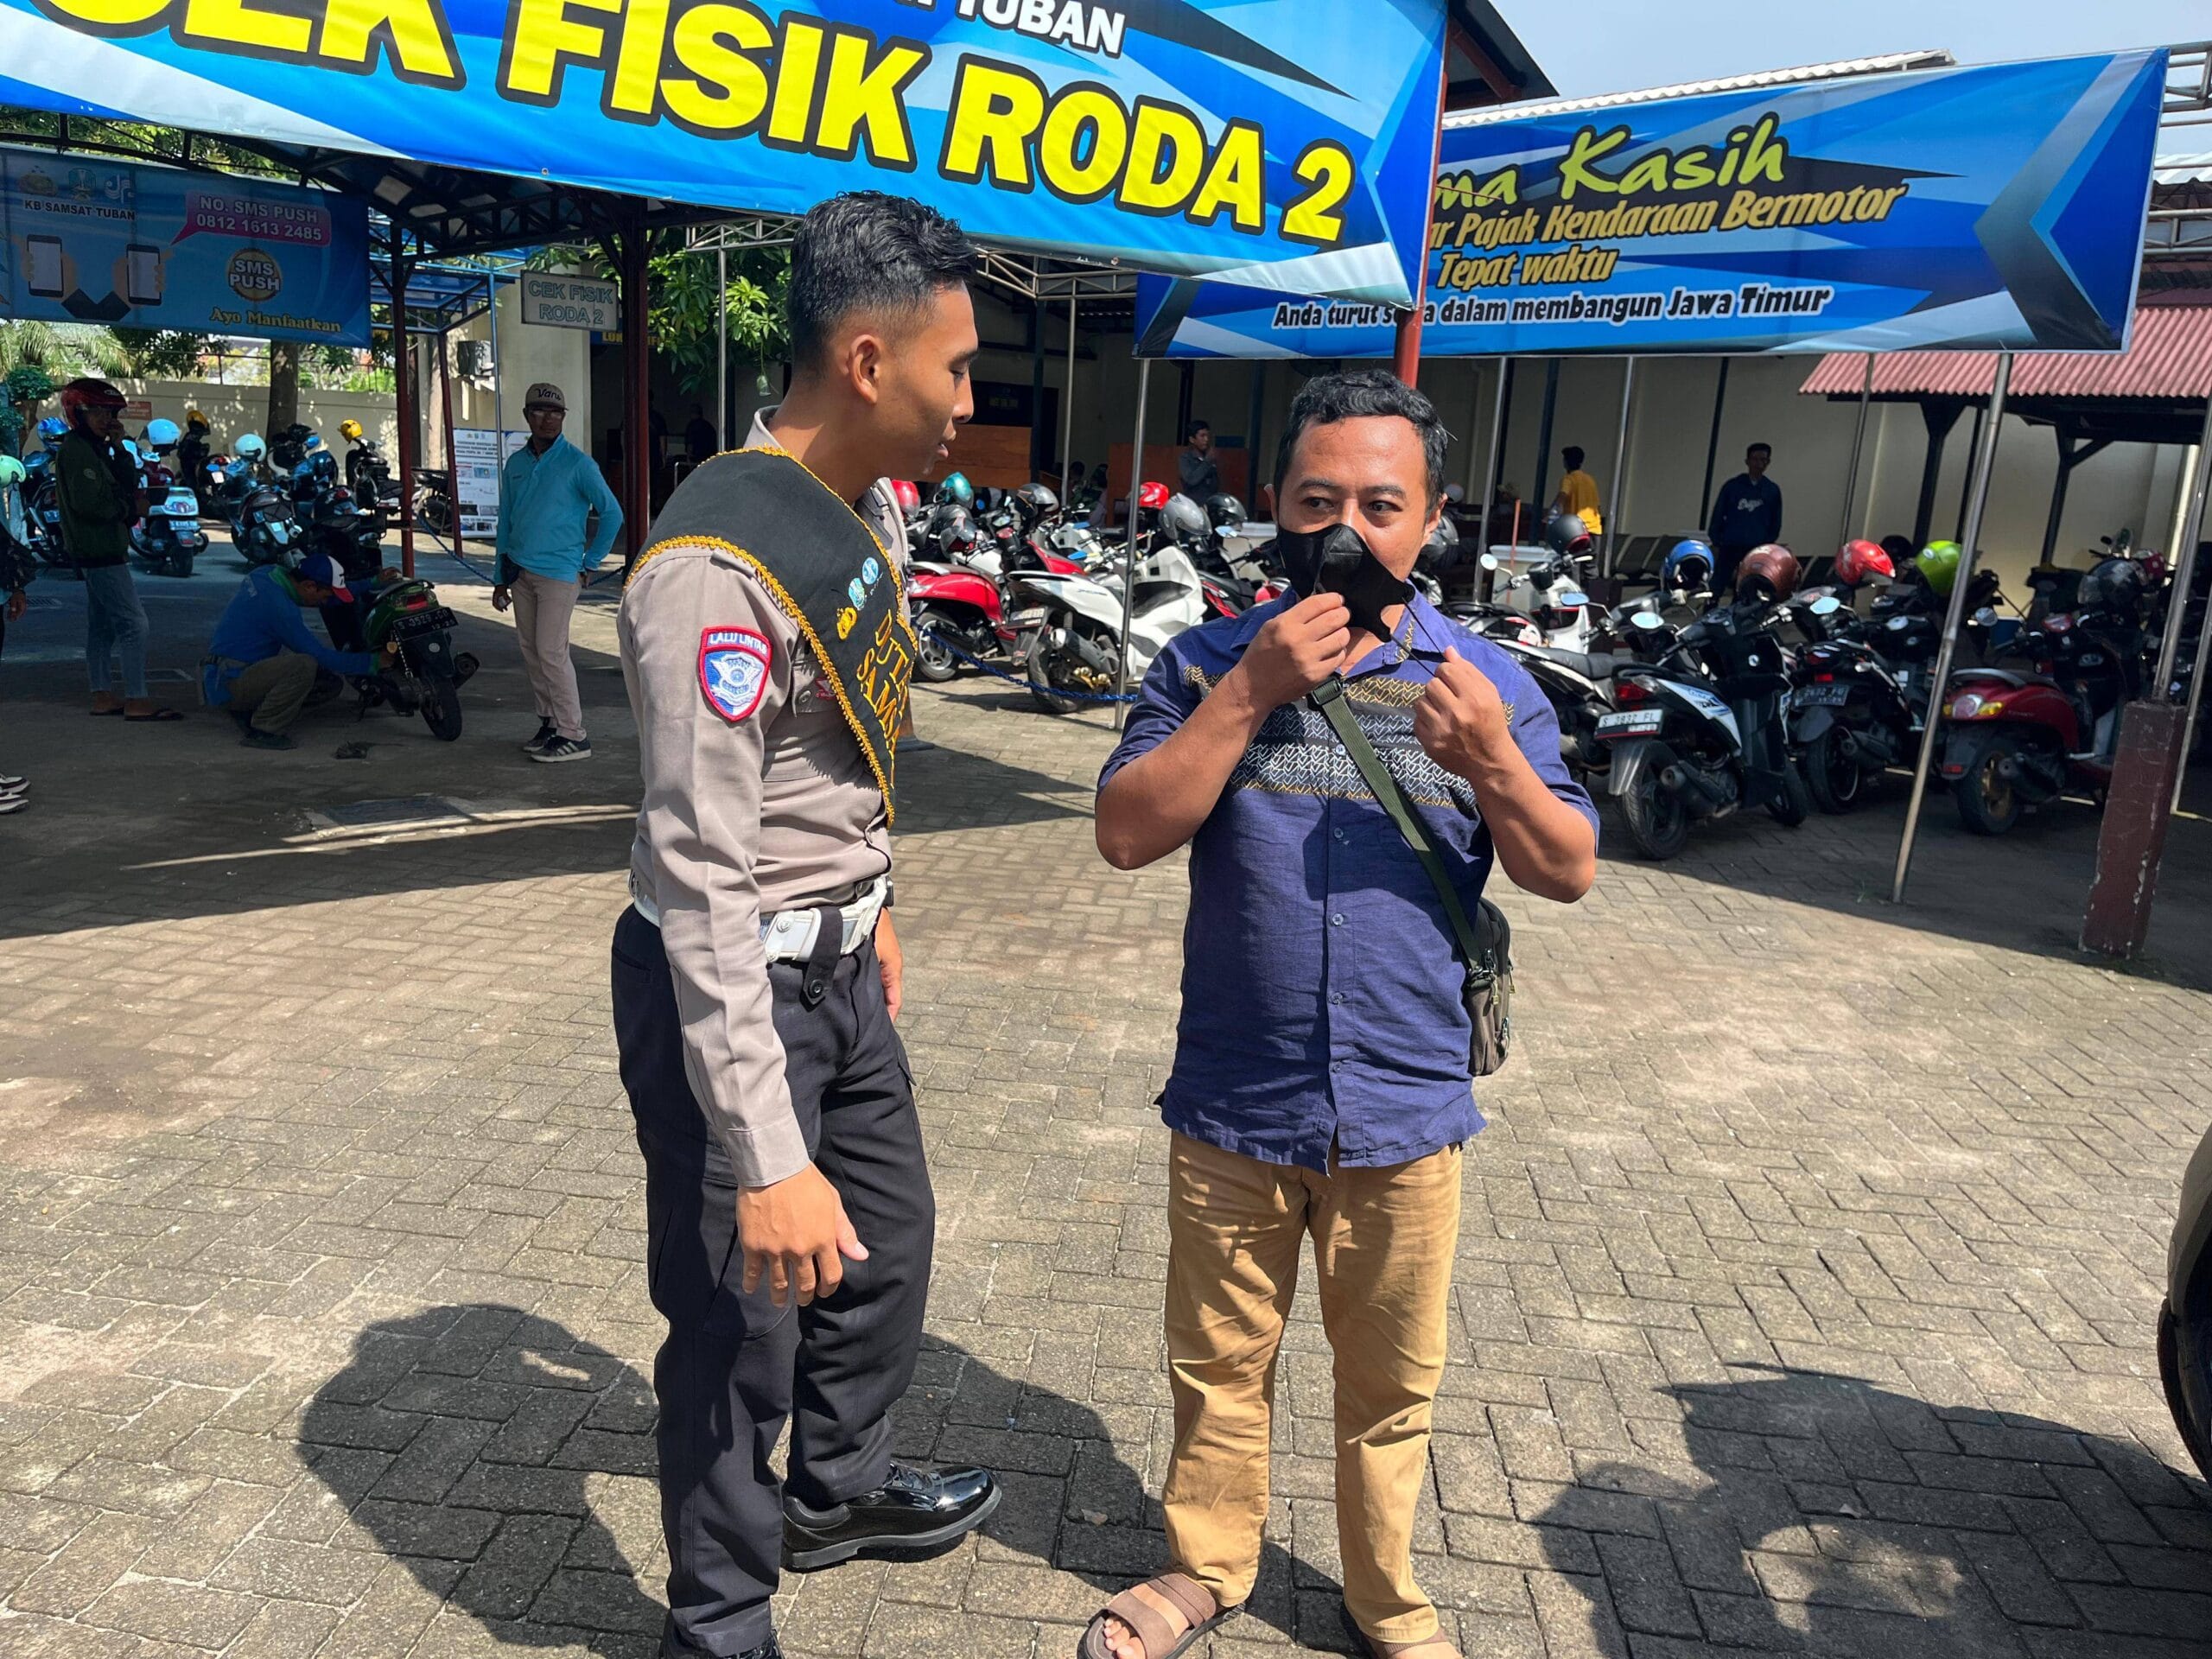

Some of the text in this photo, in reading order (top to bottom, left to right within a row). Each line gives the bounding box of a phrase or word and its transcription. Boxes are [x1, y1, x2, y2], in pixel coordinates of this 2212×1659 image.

[504, 0, 927, 168] FISIK
[943, 60, 1264, 232] RODA
[1281, 143, 1355, 245] 2
[1558, 118, 1785, 200] Kasih
[24, 200, 136, 220] KB SAMSAT TUBAN
[200, 196, 318, 224] NO. SMS PUSH
[1453, 207, 1541, 251] Pajak
[1540, 200, 1719, 242] Kendaraan
[1719, 184, 1906, 230] Bermotor
[196, 213, 322, 241] 0812 1613 2485
[234, 260, 275, 276] SMS
[1436, 245, 1619, 290] Tepat waktu
[229, 273, 281, 291] PUSH
[528, 280, 566, 300] CEK
[210, 307, 342, 333] Ayo Manfaatkan
[538, 303, 604, 325] RODA 2
[1273, 304, 1322, 327] Anda
[1327, 305, 1379, 327] turut
[1440, 299, 1507, 323] dalam
[1512, 293, 1662, 323] membangun
[1668, 289, 1729, 315] Jawa
[1739, 286, 1832, 315] Timur
[709, 632, 768, 655] LALU LINTAS
